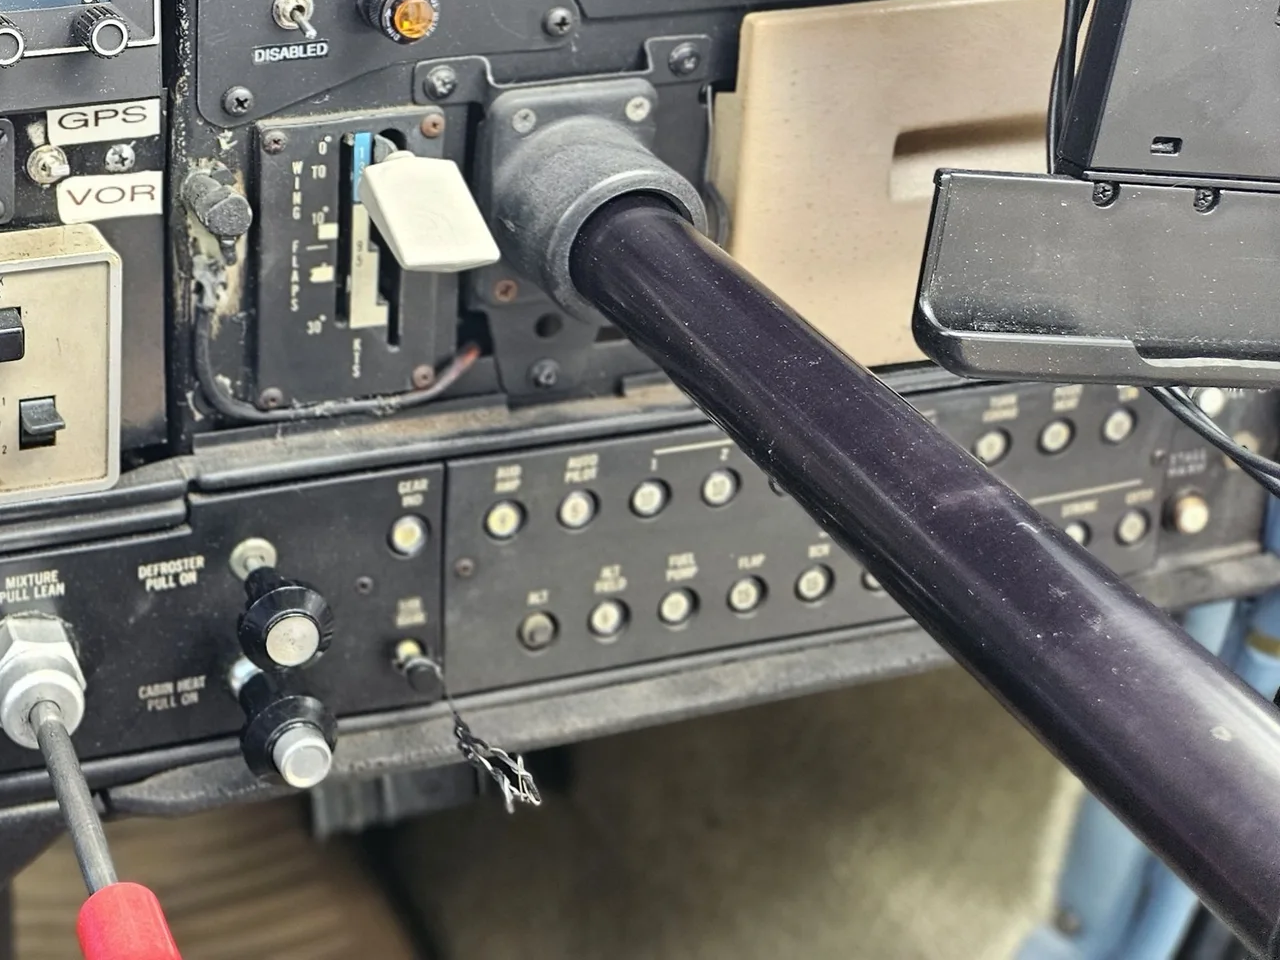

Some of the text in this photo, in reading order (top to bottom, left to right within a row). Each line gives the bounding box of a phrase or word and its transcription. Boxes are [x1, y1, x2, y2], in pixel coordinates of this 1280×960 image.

[254, 43, 329, 63] DISABLED
[58, 105, 147, 130] GPS
[66, 184, 155, 205] VOR
[138, 555, 205, 581] DEFROSTER
[5, 570, 59, 589] MIXTURE
[33, 582, 65, 600] LEAN
[177, 674, 207, 694] HEAT
